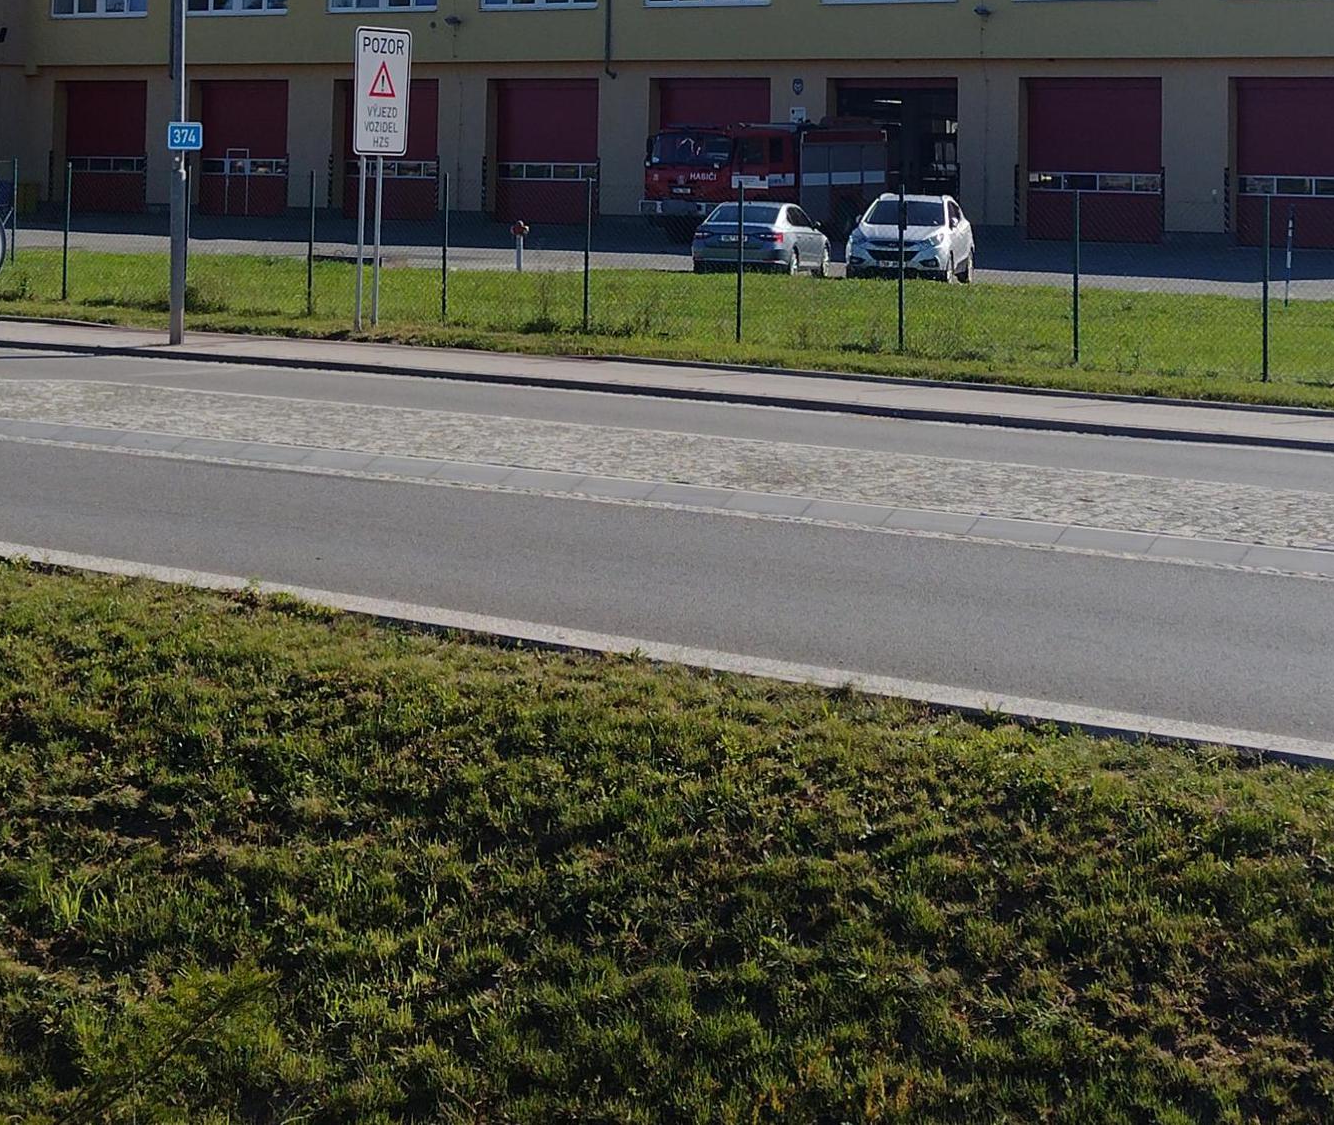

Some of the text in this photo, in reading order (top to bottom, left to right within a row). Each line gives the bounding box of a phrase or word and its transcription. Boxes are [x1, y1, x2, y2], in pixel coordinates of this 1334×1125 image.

[363, 36, 405, 55] POZOR
[367, 103, 398, 119] VÝJEZD
[364, 120, 398, 134] VOZIDEL
[173, 129, 196, 144] 374
[372, 136, 390, 148] HZS
